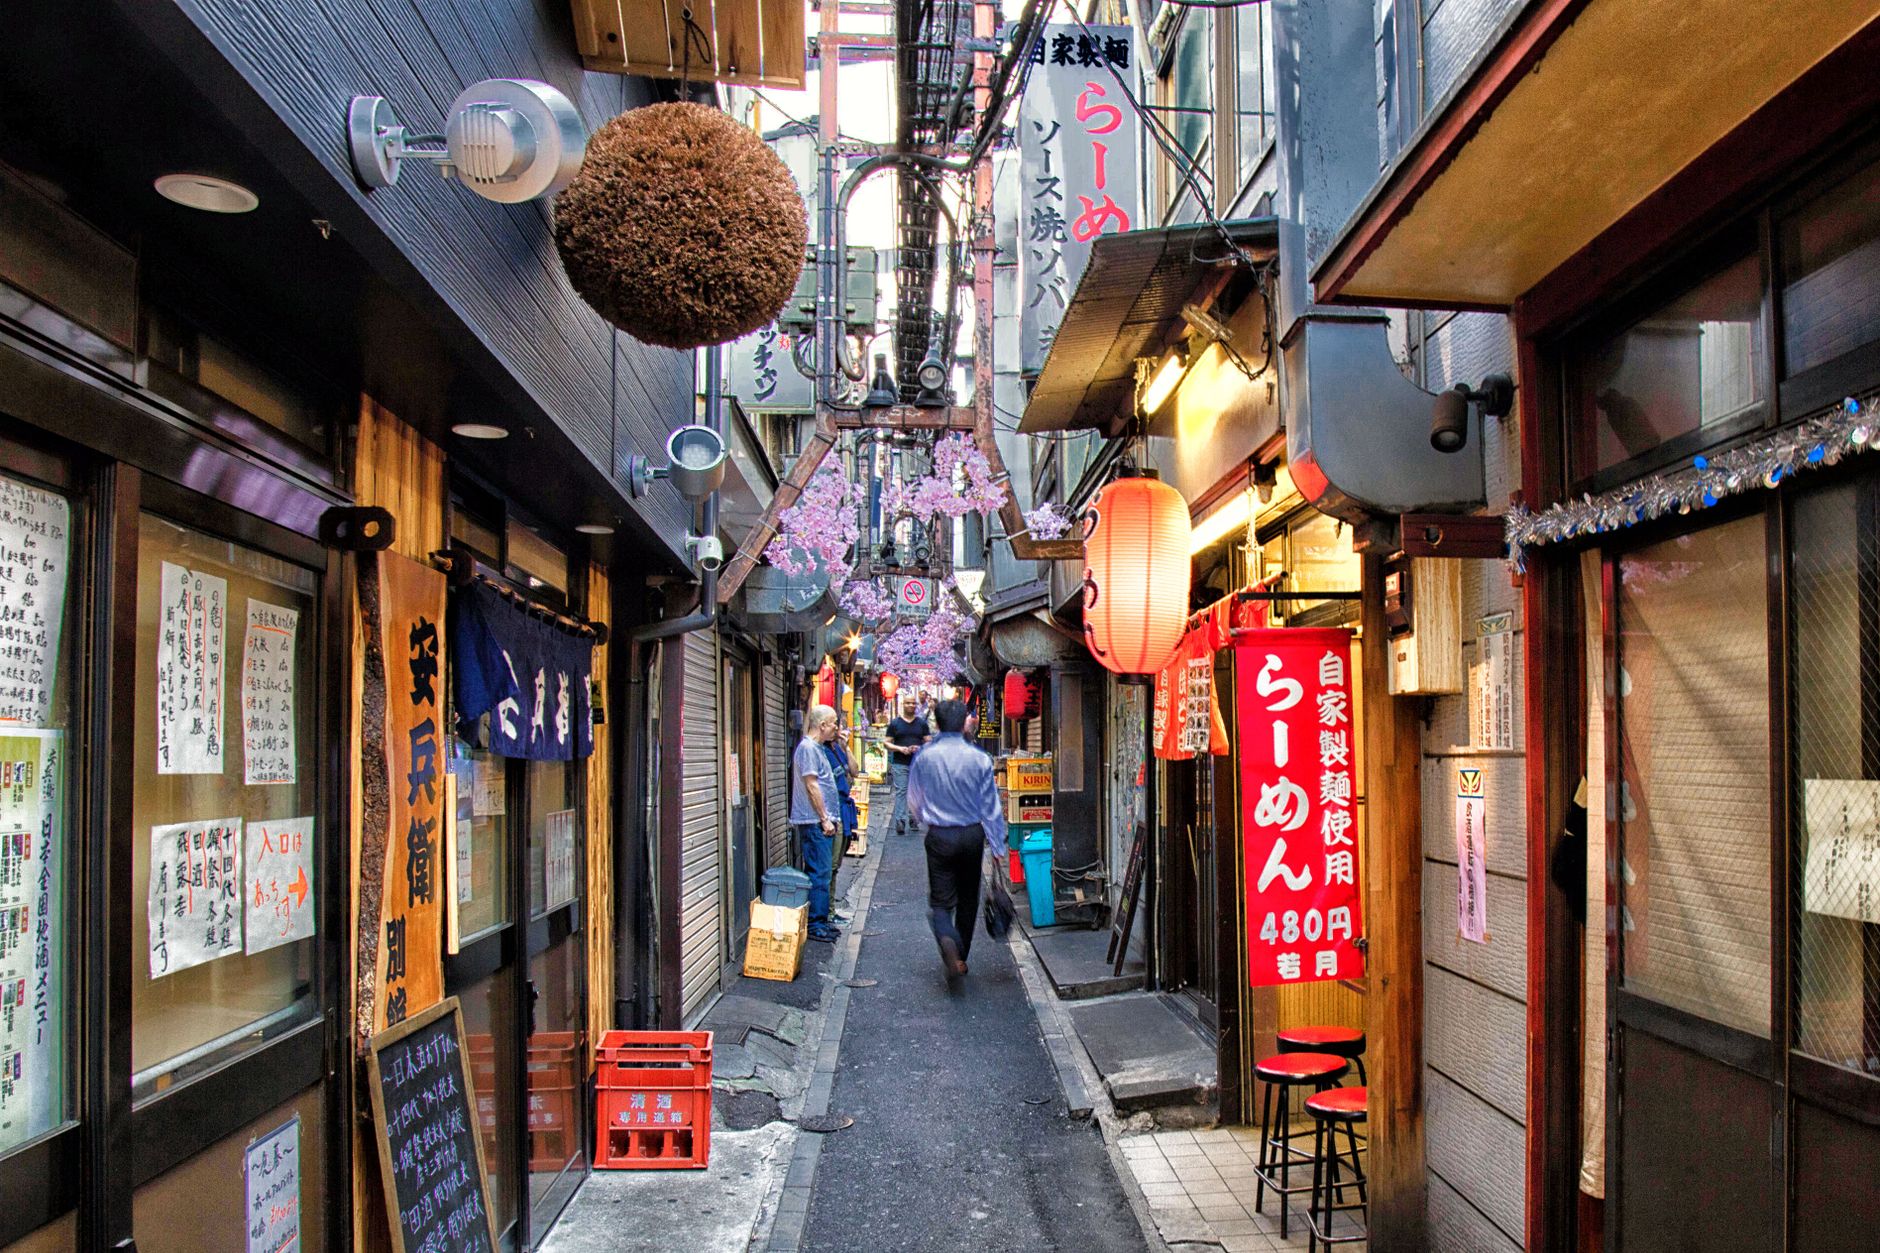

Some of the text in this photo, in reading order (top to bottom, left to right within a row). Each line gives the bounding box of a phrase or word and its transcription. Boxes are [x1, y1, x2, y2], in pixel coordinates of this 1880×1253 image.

[1029, 120, 1068, 309] ソース焼ソバ
[408, 616, 439, 907] 安兵衛
[1023, 775, 1051, 785] KIRIN
[1253, 653, 1313, 893] らーめん
[1316, 650, 1354, 888] 自家製麺使用
[258, 827, 302, 864] 入口は
[1259, 905, 1353, 945] 480円
[1276, 950, 1338, 980] 若月
[630, 1093, 673, 1109] 清酒
